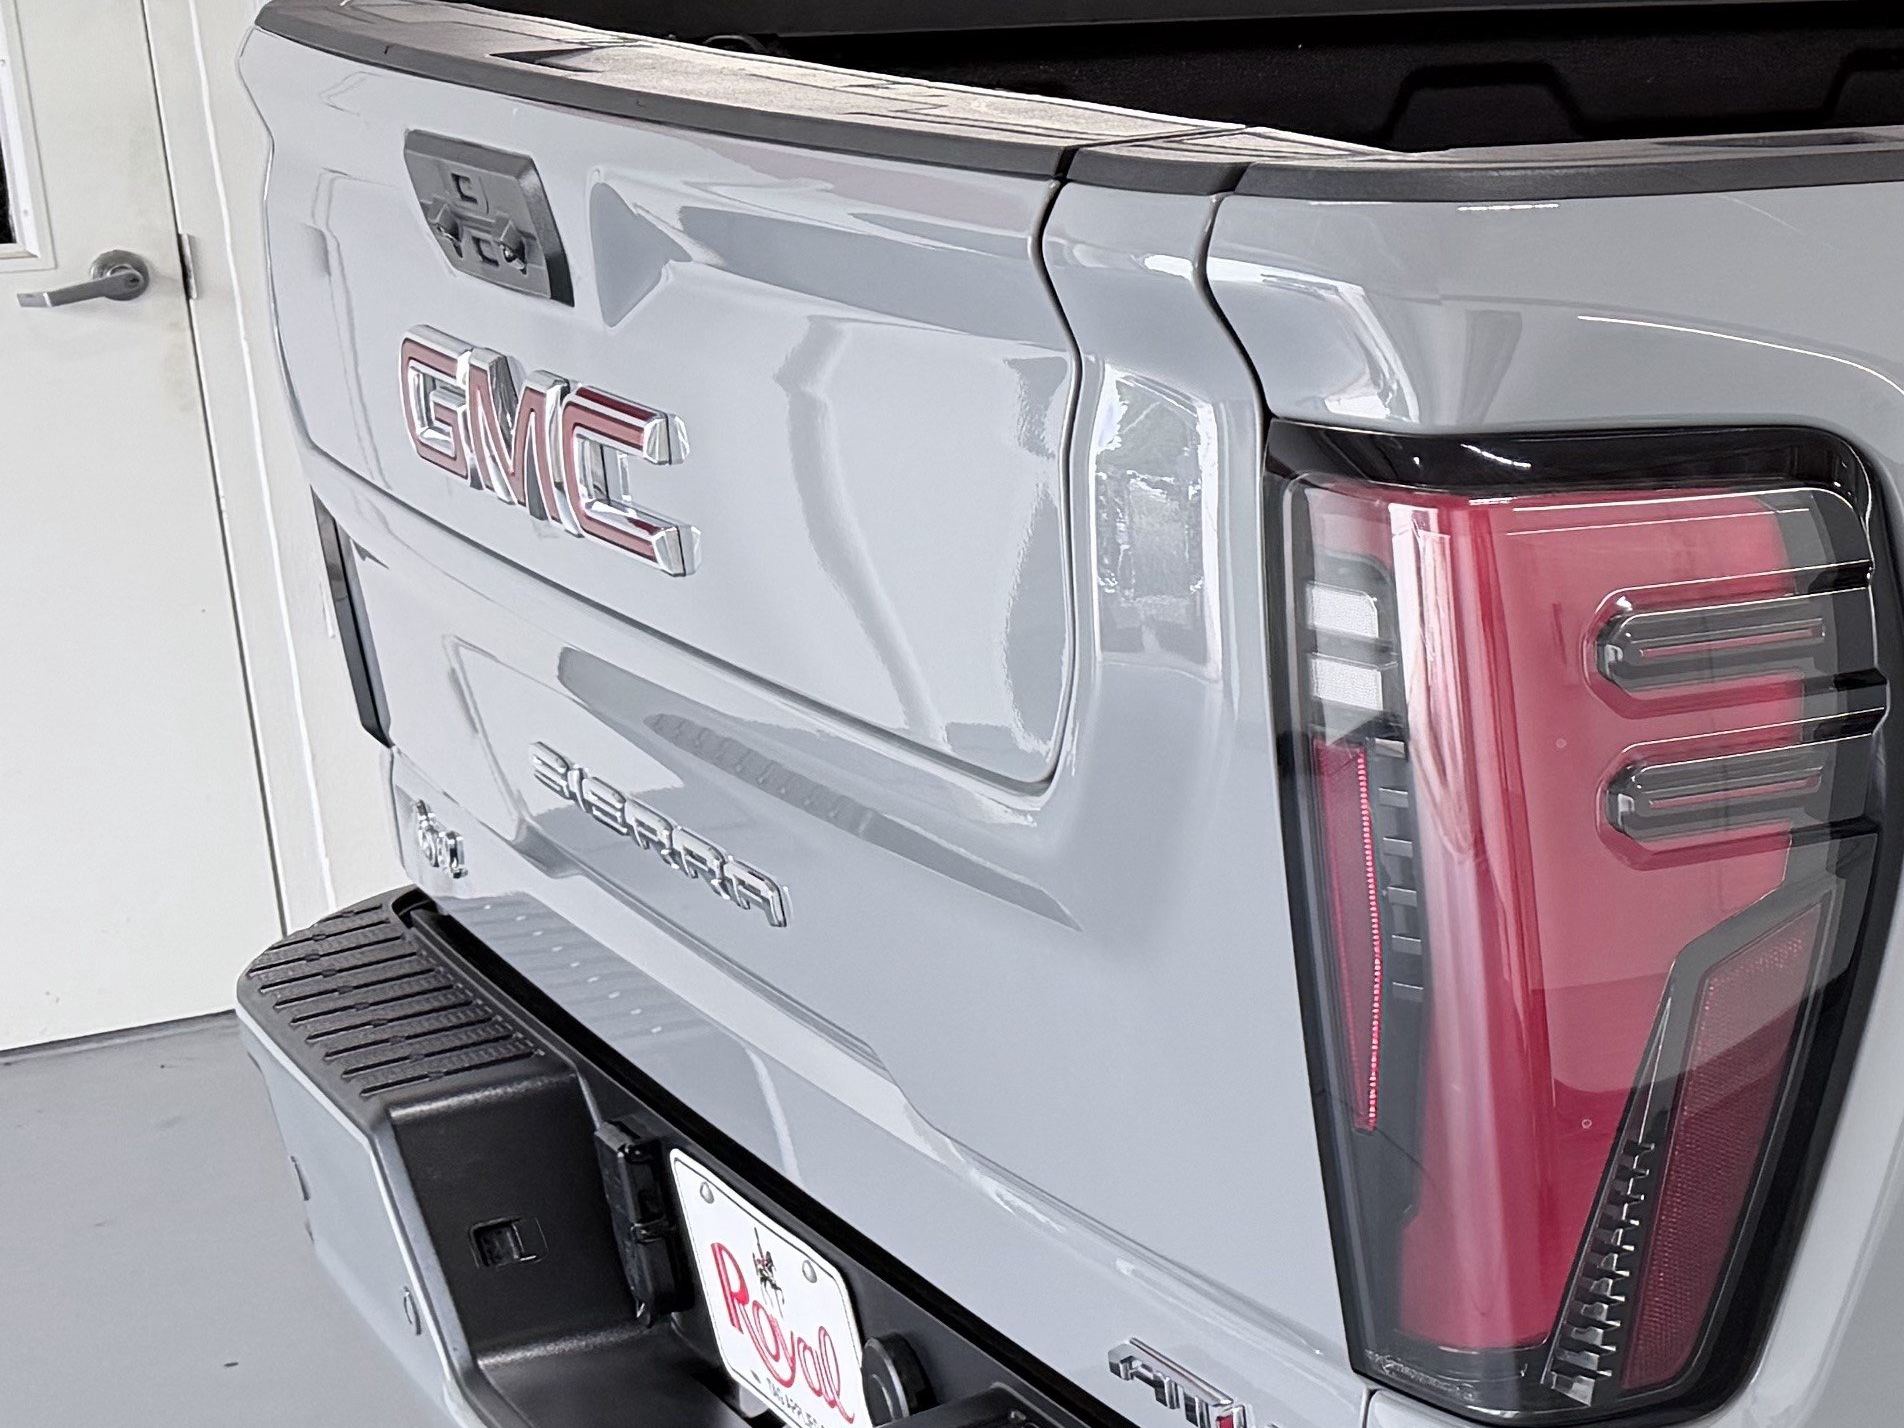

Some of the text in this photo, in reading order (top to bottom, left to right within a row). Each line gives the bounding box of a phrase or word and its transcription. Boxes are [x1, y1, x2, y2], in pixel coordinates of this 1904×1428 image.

[399, 323, 702, 578] GMC
[528, 740, 789, 928] SIERRA
[710, 1241, 856, 1425] Royal
